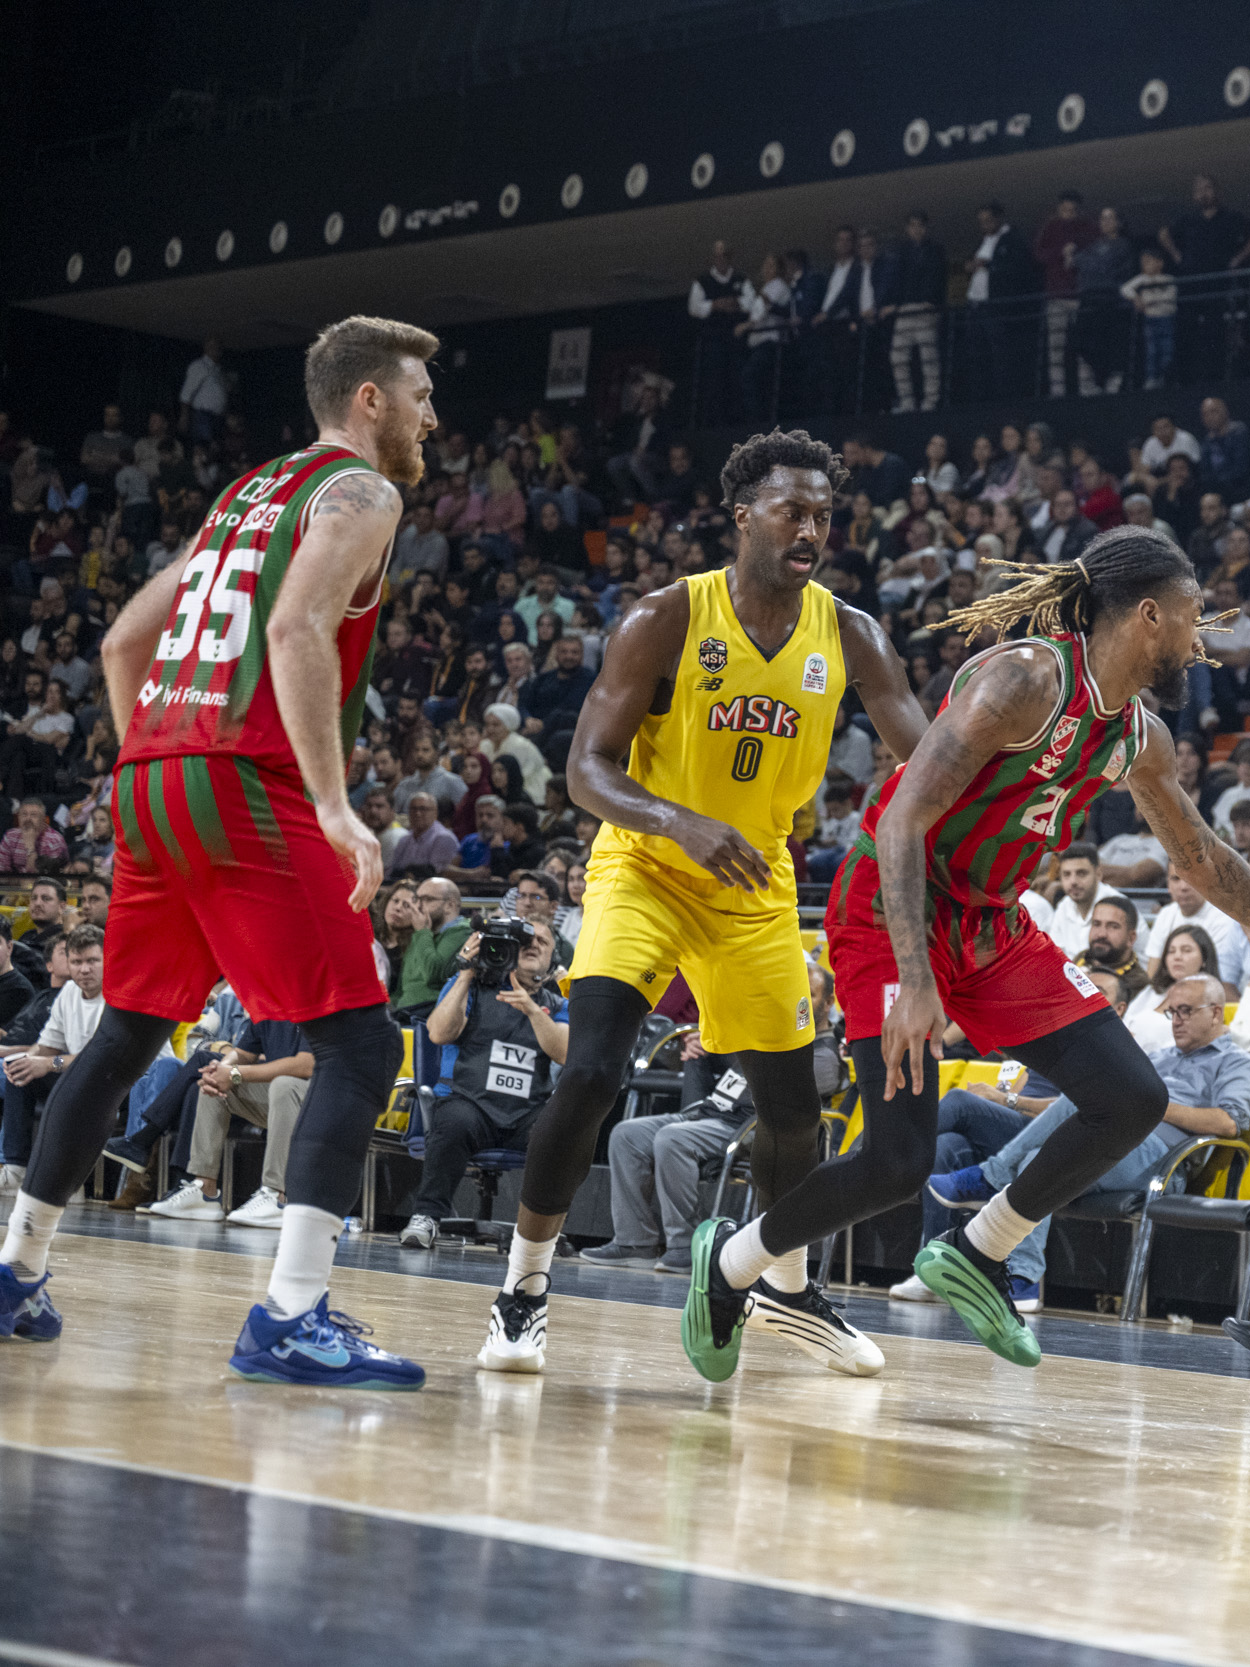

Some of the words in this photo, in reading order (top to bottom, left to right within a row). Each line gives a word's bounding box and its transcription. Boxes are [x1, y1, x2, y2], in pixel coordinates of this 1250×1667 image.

[156, 548, 266, 662] 35
[700, 653, 727, 664] MSK
[181, 685, 230, 707] Finans
[707, 694, 802, 738] MSK
[731, 736, 763, 782] 0
[502, 1045, 527, 1064] TV
[495, 1074, 523, 1090] 603
